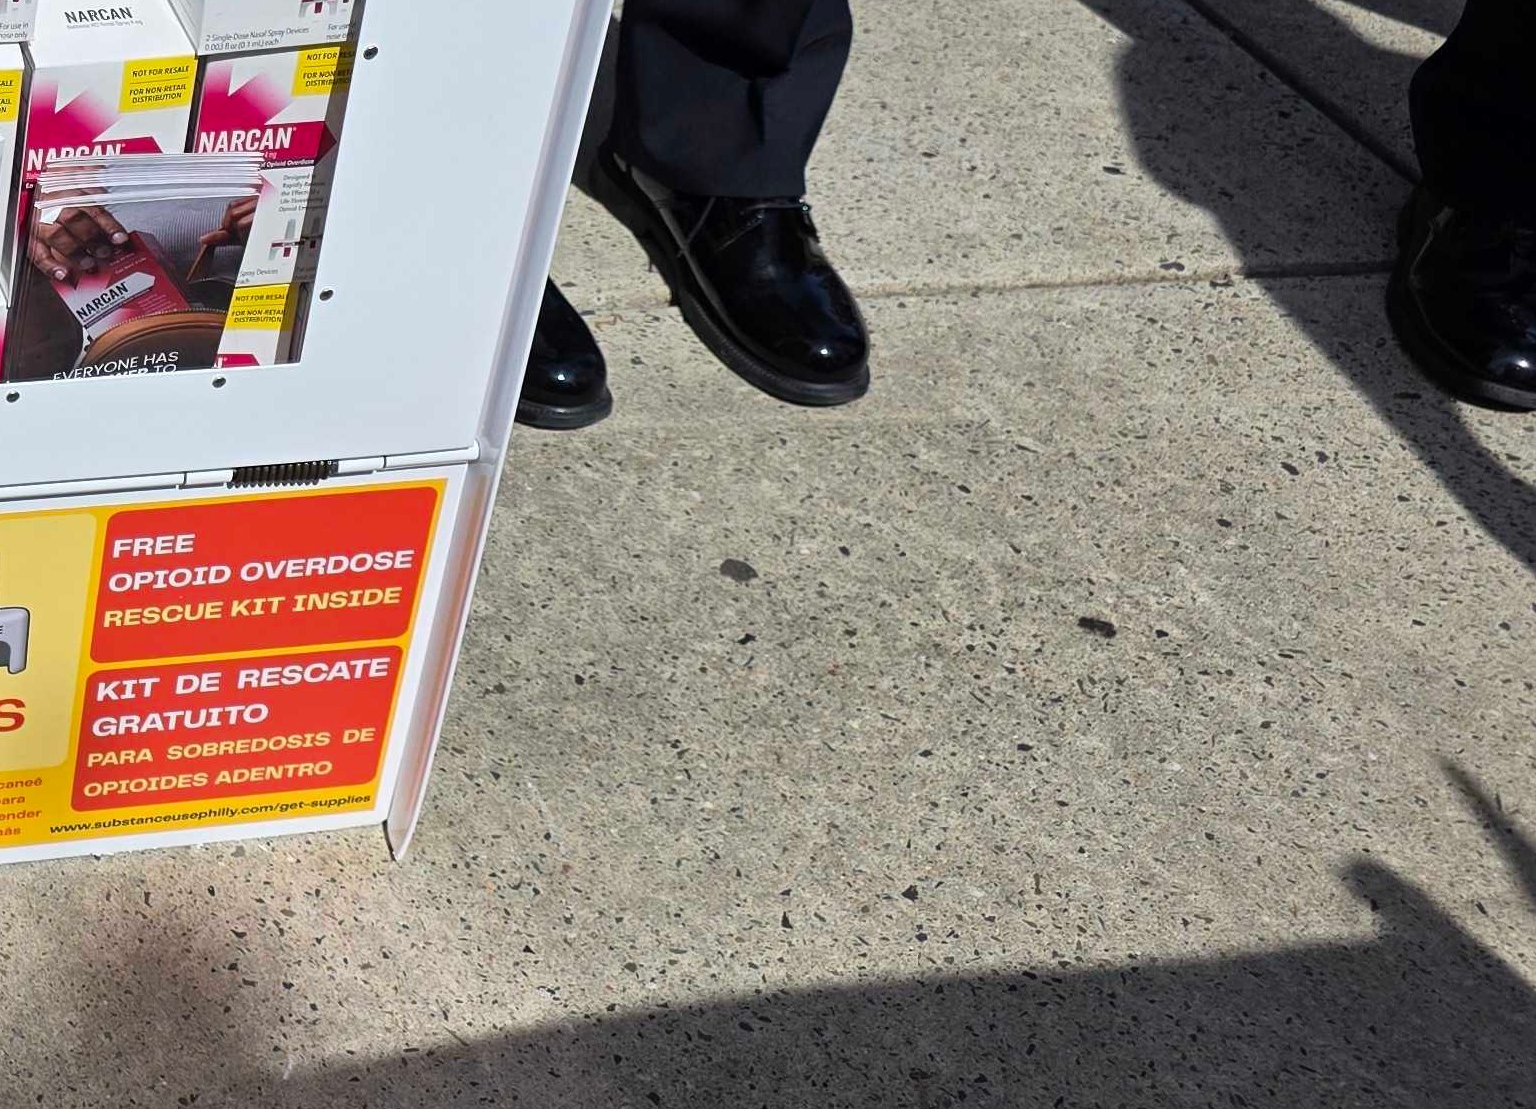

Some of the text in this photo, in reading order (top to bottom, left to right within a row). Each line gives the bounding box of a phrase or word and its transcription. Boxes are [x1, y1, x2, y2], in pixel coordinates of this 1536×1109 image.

[64, 6, 133, 24] NARCAN
[165, 66, 189, 74] RESALE
[133, 93, 181, 103] DISTRIBUTION
[146, 84, 186, 94] NON-RETAIL
[198, 126, 293, 154] NARCAN
[75, 282, 130, 319] NARCAN
[144, 352, 179, 365] HAS
[112, 533, 196, 558] FREE
[108, 549, 415, 593] OPIOID OVERDOSE
[103, 587, 403, 628] RESCUE KIT INSIDE
[96, 657, 391, 702] KIT DE RESCATE
[92, 703, 269, 737] GRATUITO
[87, 727, 377, 767] PARA SOBREDOSIS DE
[83, 760, 333, 798] OPIOIDES ADENTRO
[49, 794, 371, 834] www.substanceusephilly.com/get-supplies
